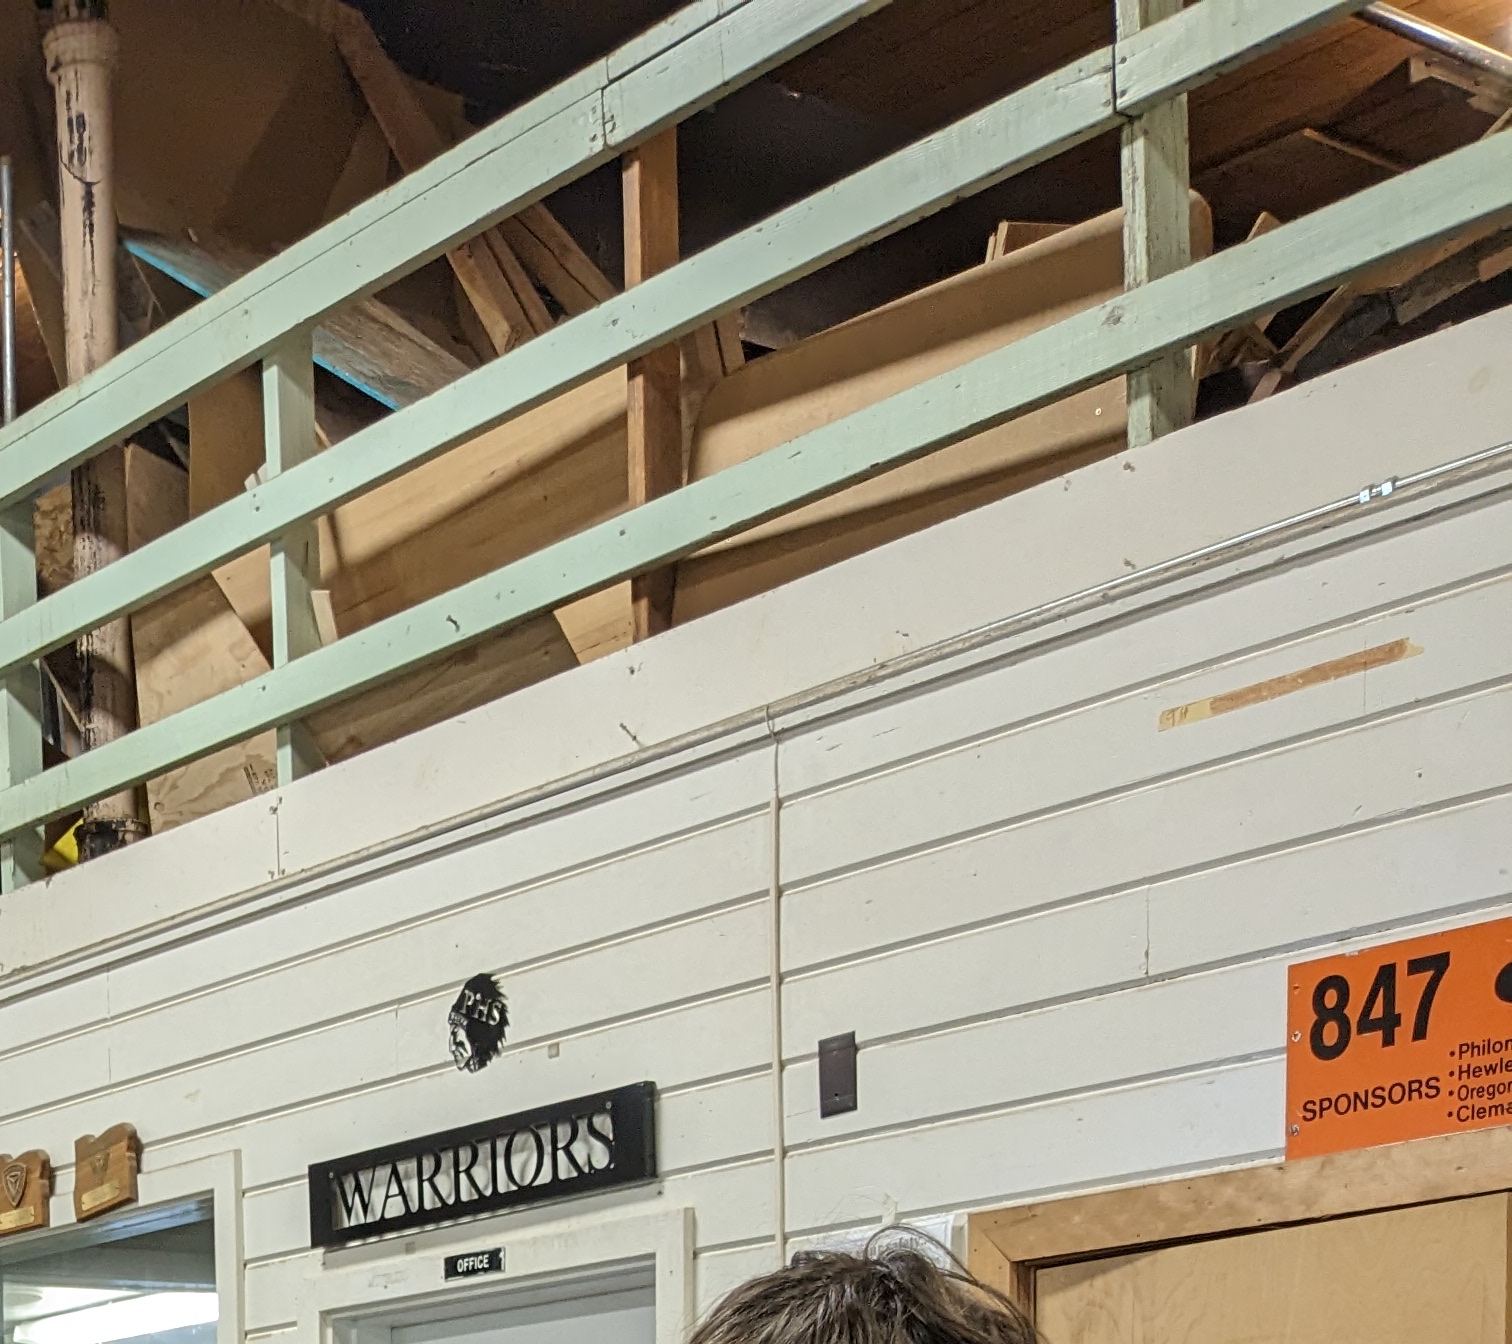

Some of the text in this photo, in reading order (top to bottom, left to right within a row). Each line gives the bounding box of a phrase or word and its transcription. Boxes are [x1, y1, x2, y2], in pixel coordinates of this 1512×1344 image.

[1309, 951, 1451, 1061] 847
[1301, 1076, 1441, 1122] SPONSORS
[333, 1110, 615, 1226] WARRIORS
[456, 1254, 490, 1273] OFFICE
